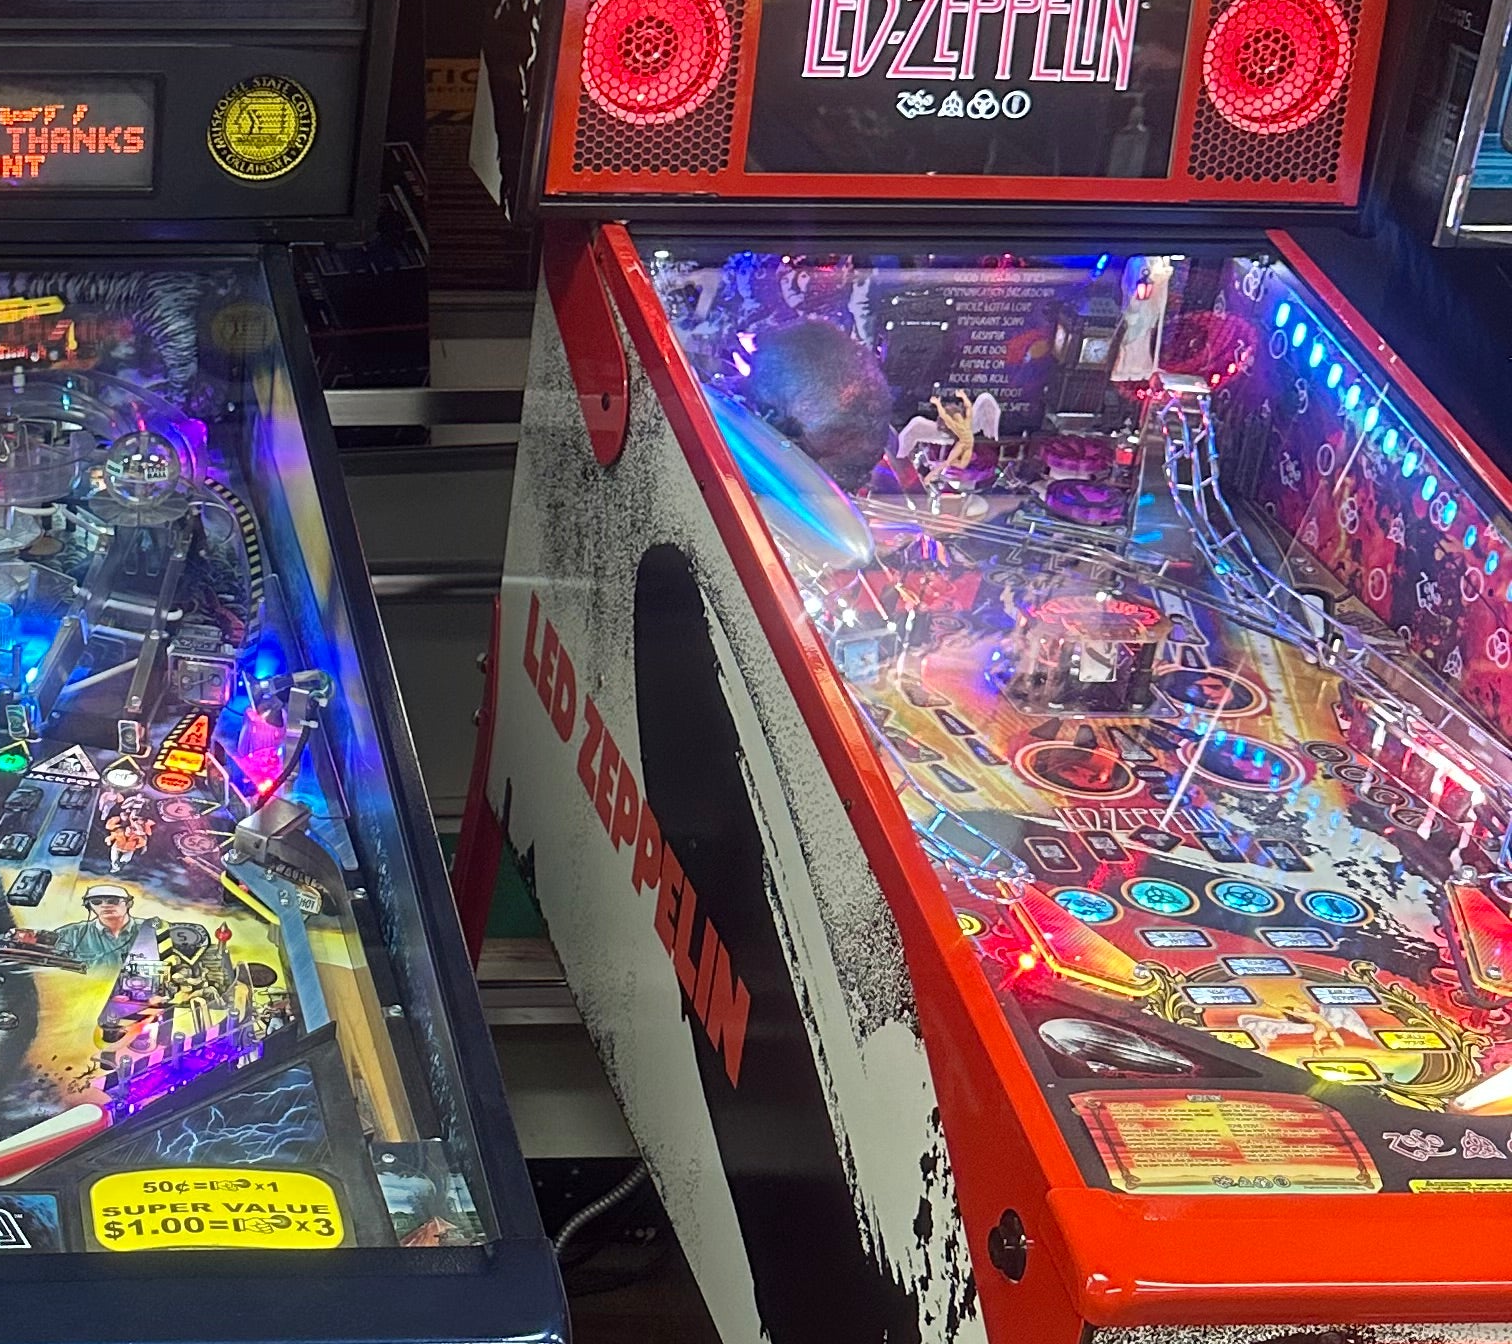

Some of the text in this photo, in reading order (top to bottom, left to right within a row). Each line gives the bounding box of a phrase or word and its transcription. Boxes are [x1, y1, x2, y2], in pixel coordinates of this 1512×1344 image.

[252, 76, 292, 94] STATE
[6, 126, 145, 154] THANKS
[25, 772, 101, 787] JACKPOT
[523, 591, 751, 1089] LED ZEPPELIN
[102, 1203, 331, 1215] SUPER VALUE
